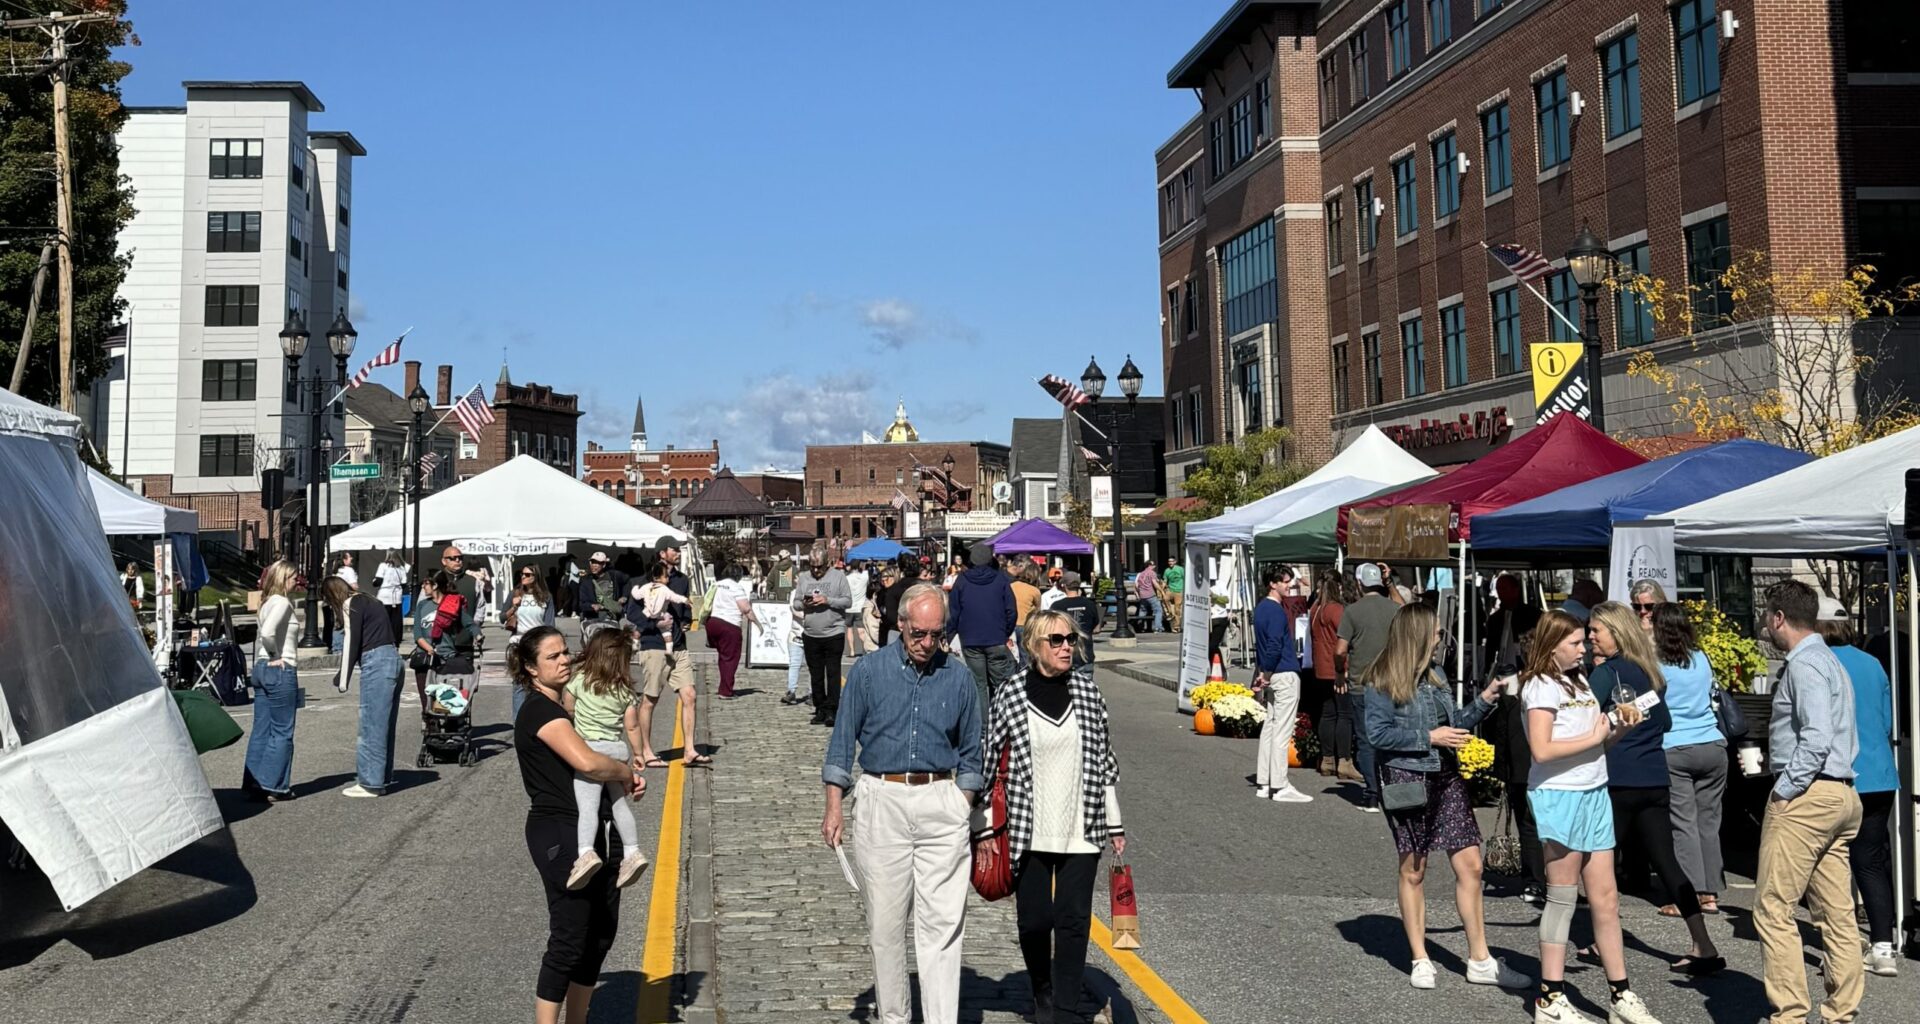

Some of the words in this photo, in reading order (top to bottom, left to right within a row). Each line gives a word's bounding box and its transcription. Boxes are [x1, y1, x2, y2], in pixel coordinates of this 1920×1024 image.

[1473, 406, 1507, 445] Café
[333, 468, 368, 477] Thompson
[468, 542, 499, 553] Book
[503, 541, 549, 555] Signing
[1639, 567, 1668, 579] READING
